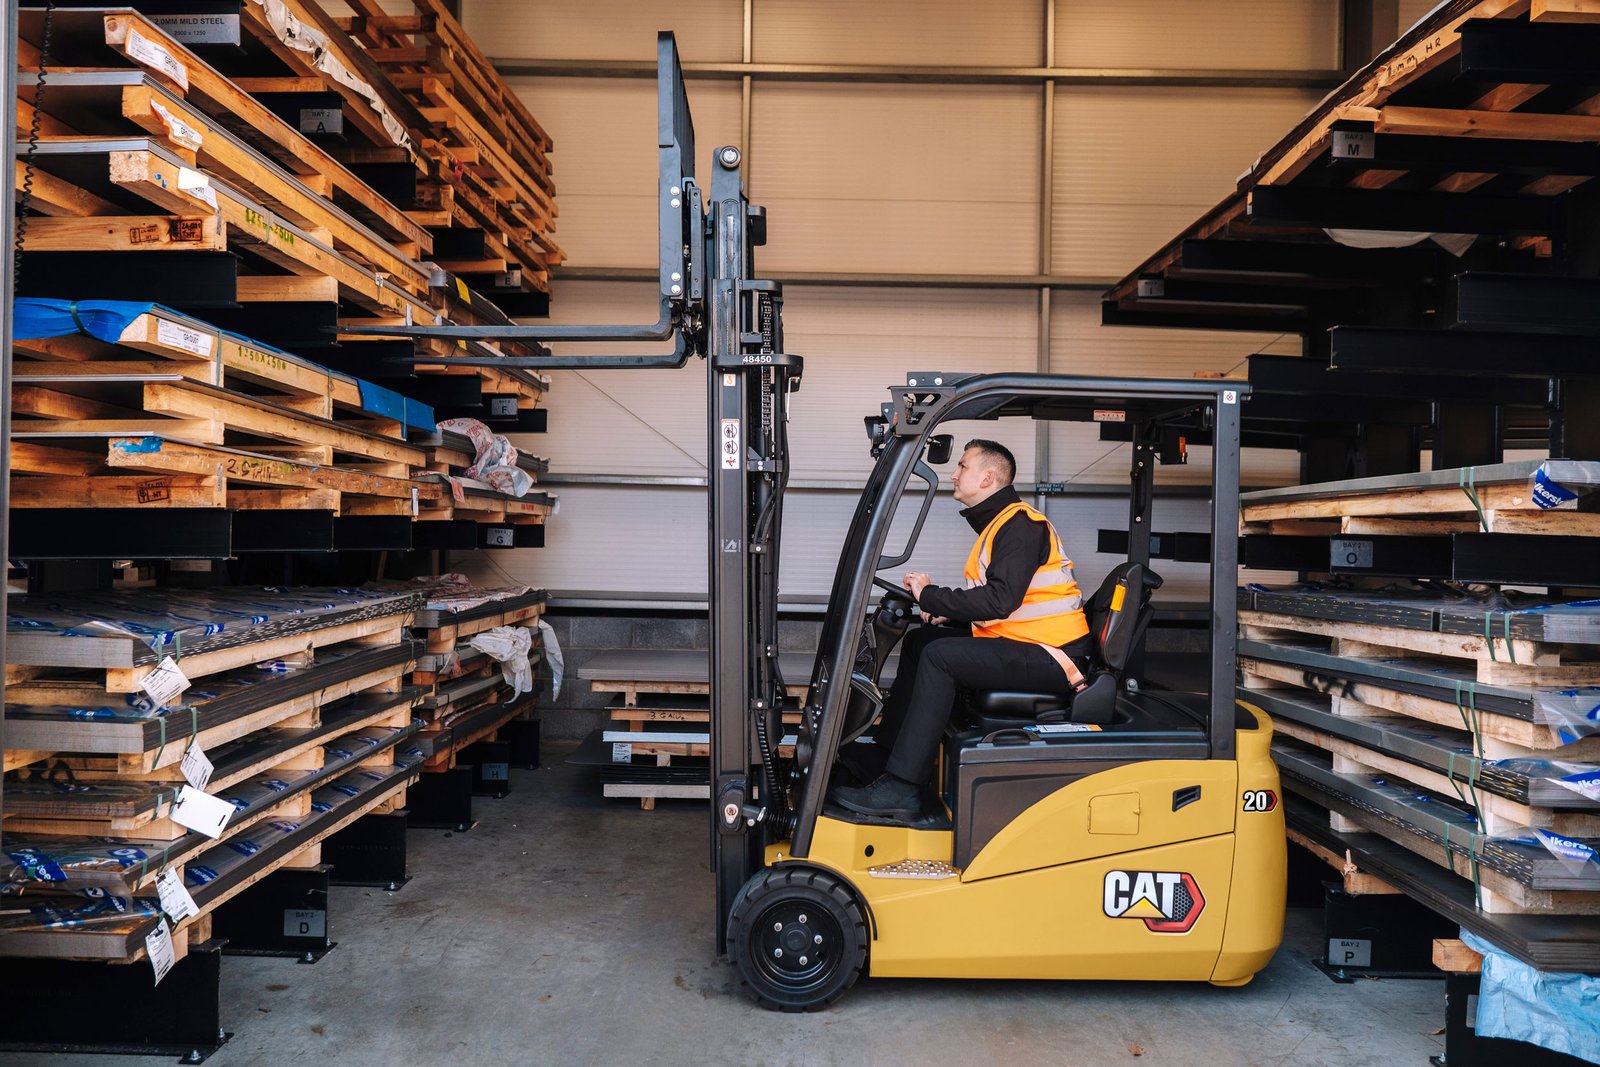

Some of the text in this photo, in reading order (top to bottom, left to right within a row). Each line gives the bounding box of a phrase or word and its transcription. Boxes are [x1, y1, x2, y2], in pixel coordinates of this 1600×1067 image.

[1426, 37, 1441, 53] HR
[316, 121, 326, 134] A
[1348, 144, 1360, 156] M
[502, 406, 508, 414] F
[496, 536, 504, 544] G
[1244, 791, 1267, 811] 20
[1104, 870, 1181, 919] CAT
[300, 922, 309, 934] D
[1345, 951, 1354, 963] P
